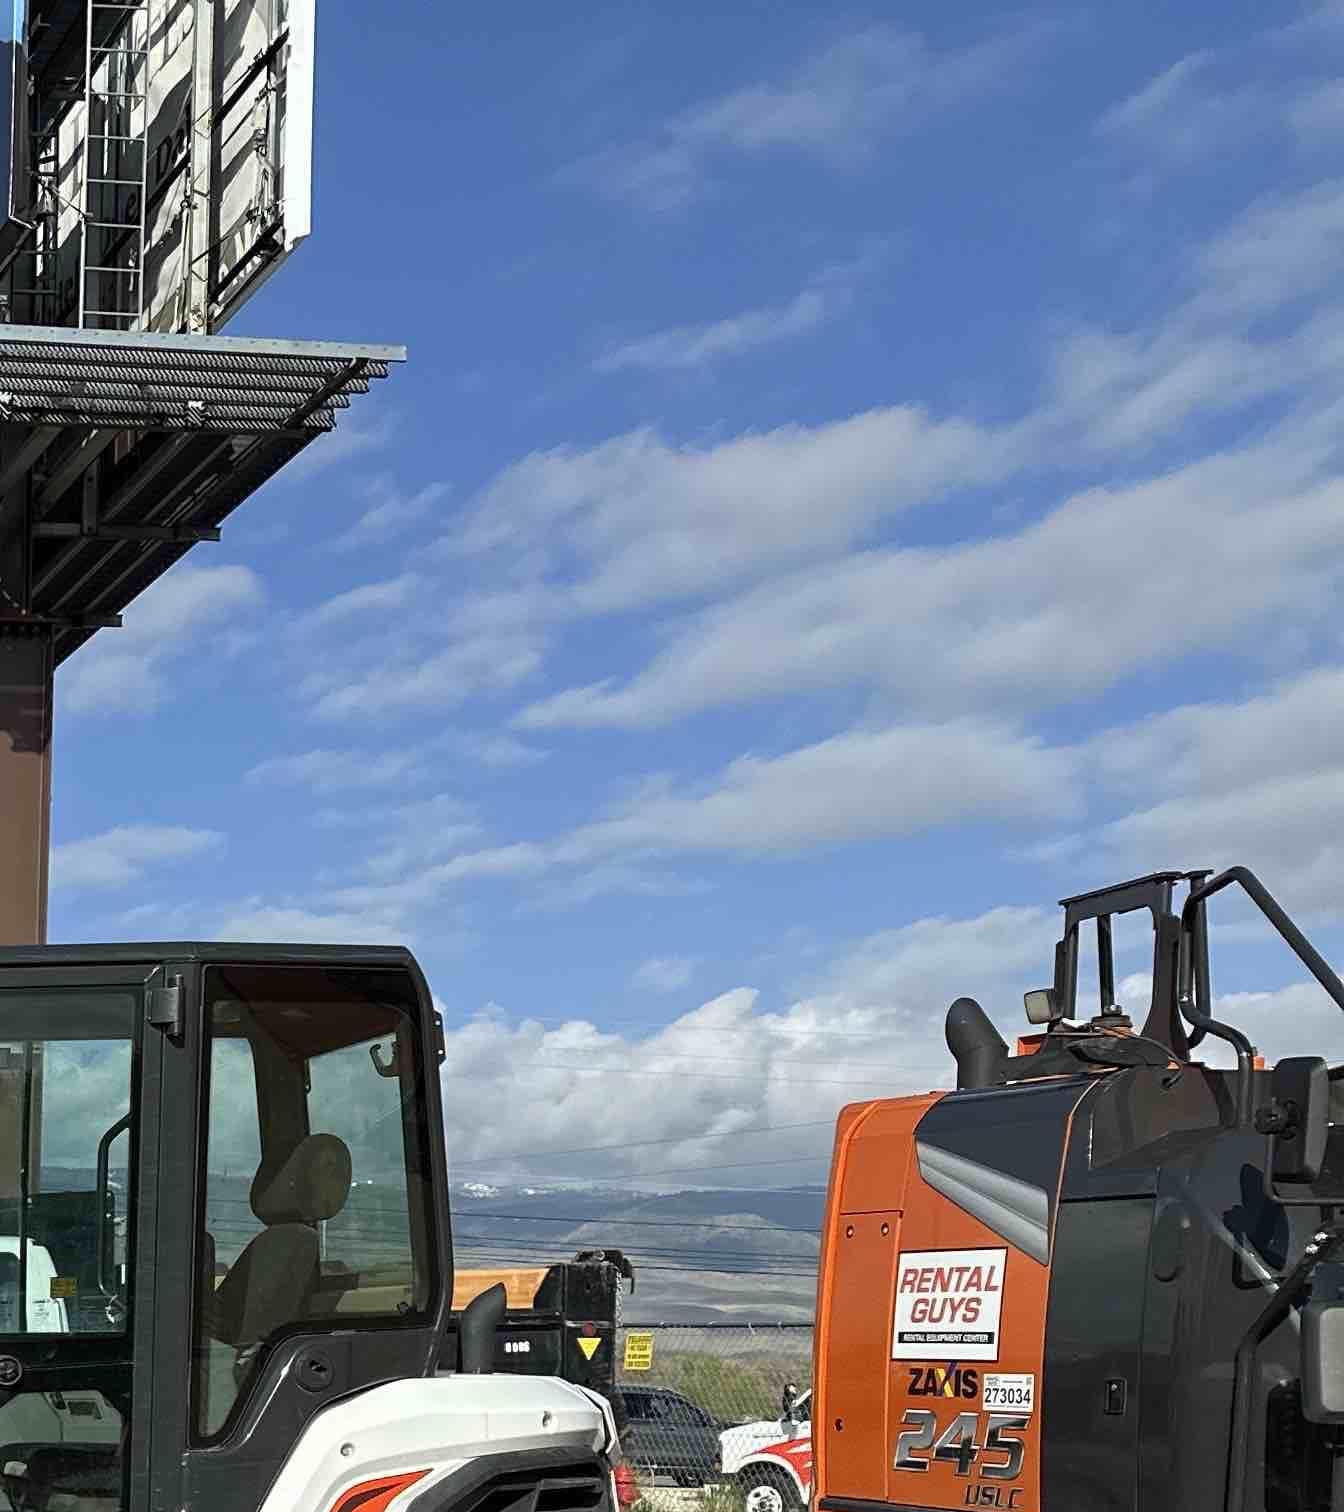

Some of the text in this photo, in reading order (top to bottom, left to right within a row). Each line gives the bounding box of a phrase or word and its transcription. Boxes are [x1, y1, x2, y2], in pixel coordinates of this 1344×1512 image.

[900, 1265, 1000, 1293] RENTAL
[910, 1297, 982, 1324] GUYS
[908, 1362, 978, 1398] ZAXIS
[985, 1387, 1031, 1404] 273034
[893, 1408, 1031, 1480] 245
[965, 1485, 1024, 1508] USLC
